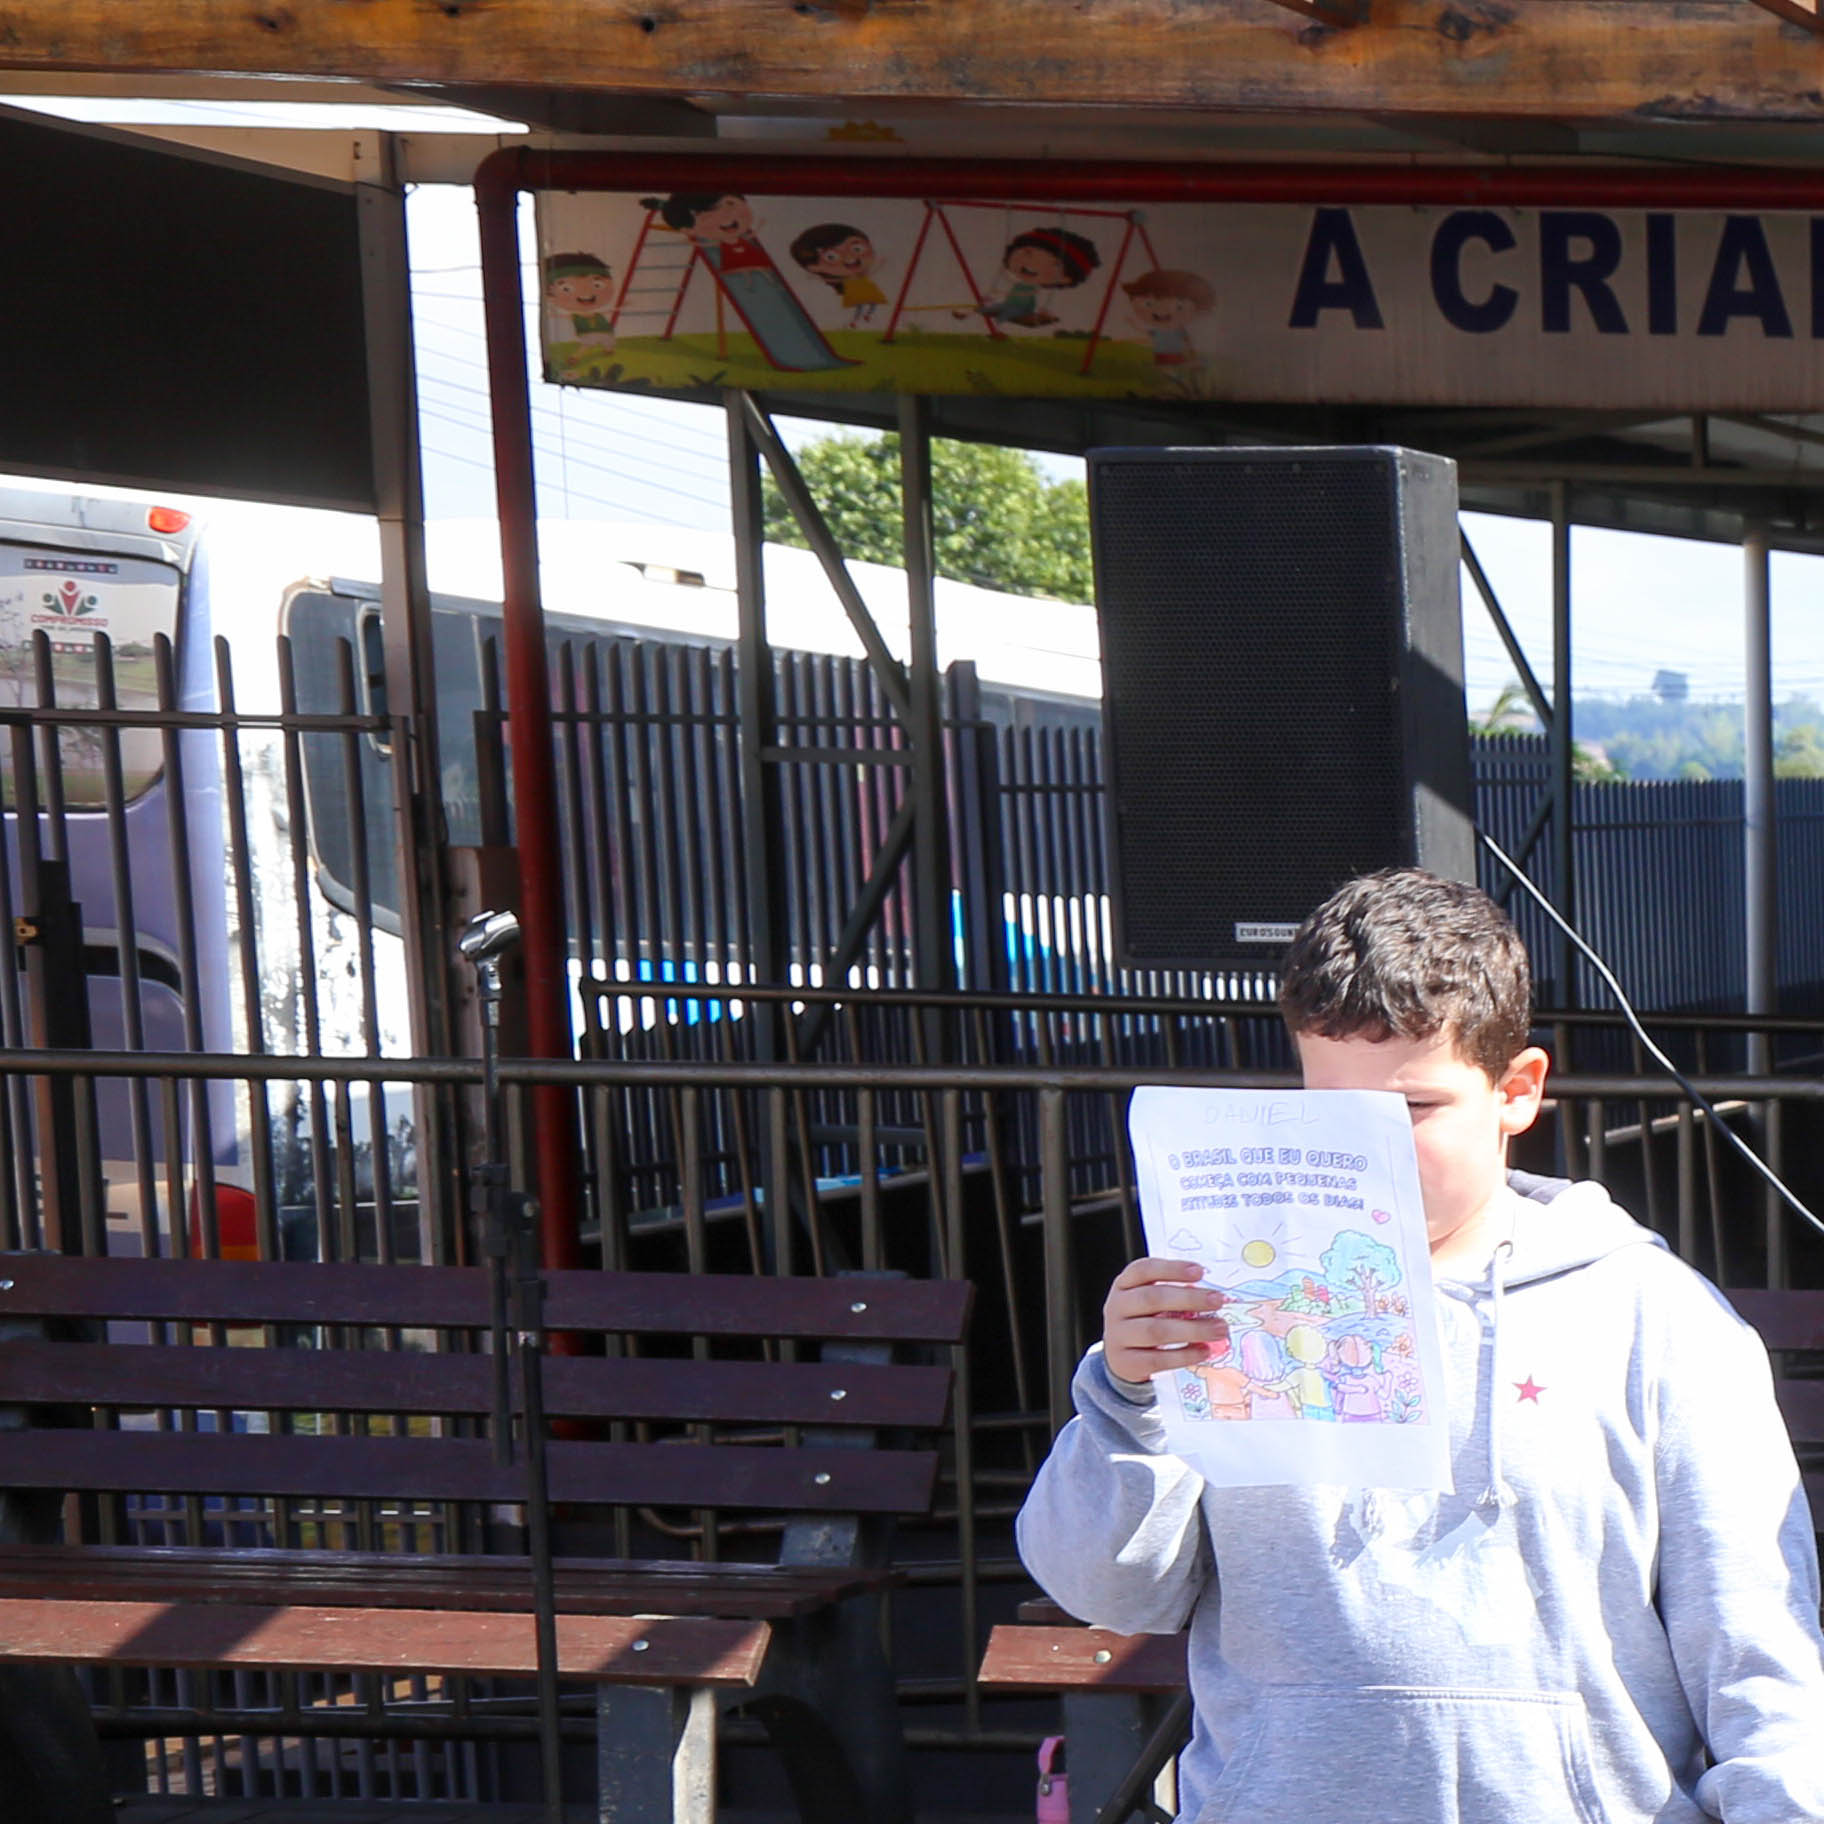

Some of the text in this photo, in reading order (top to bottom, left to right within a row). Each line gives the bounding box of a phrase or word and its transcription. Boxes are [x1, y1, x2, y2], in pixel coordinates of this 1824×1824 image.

[1289, 207, 1385, 329] A
[1168, 1147, 1368, 1172] O BRASIL QUE EU QUERO
[1180, 1172, 1358, 1191] COMEÇA COM PEQUENAS
[1241, 1191, 1294, 1207] TODOS
[1297, 1192, 1319, 1206] OS
[1323, 1193, 1364, 1210] DIAS!
